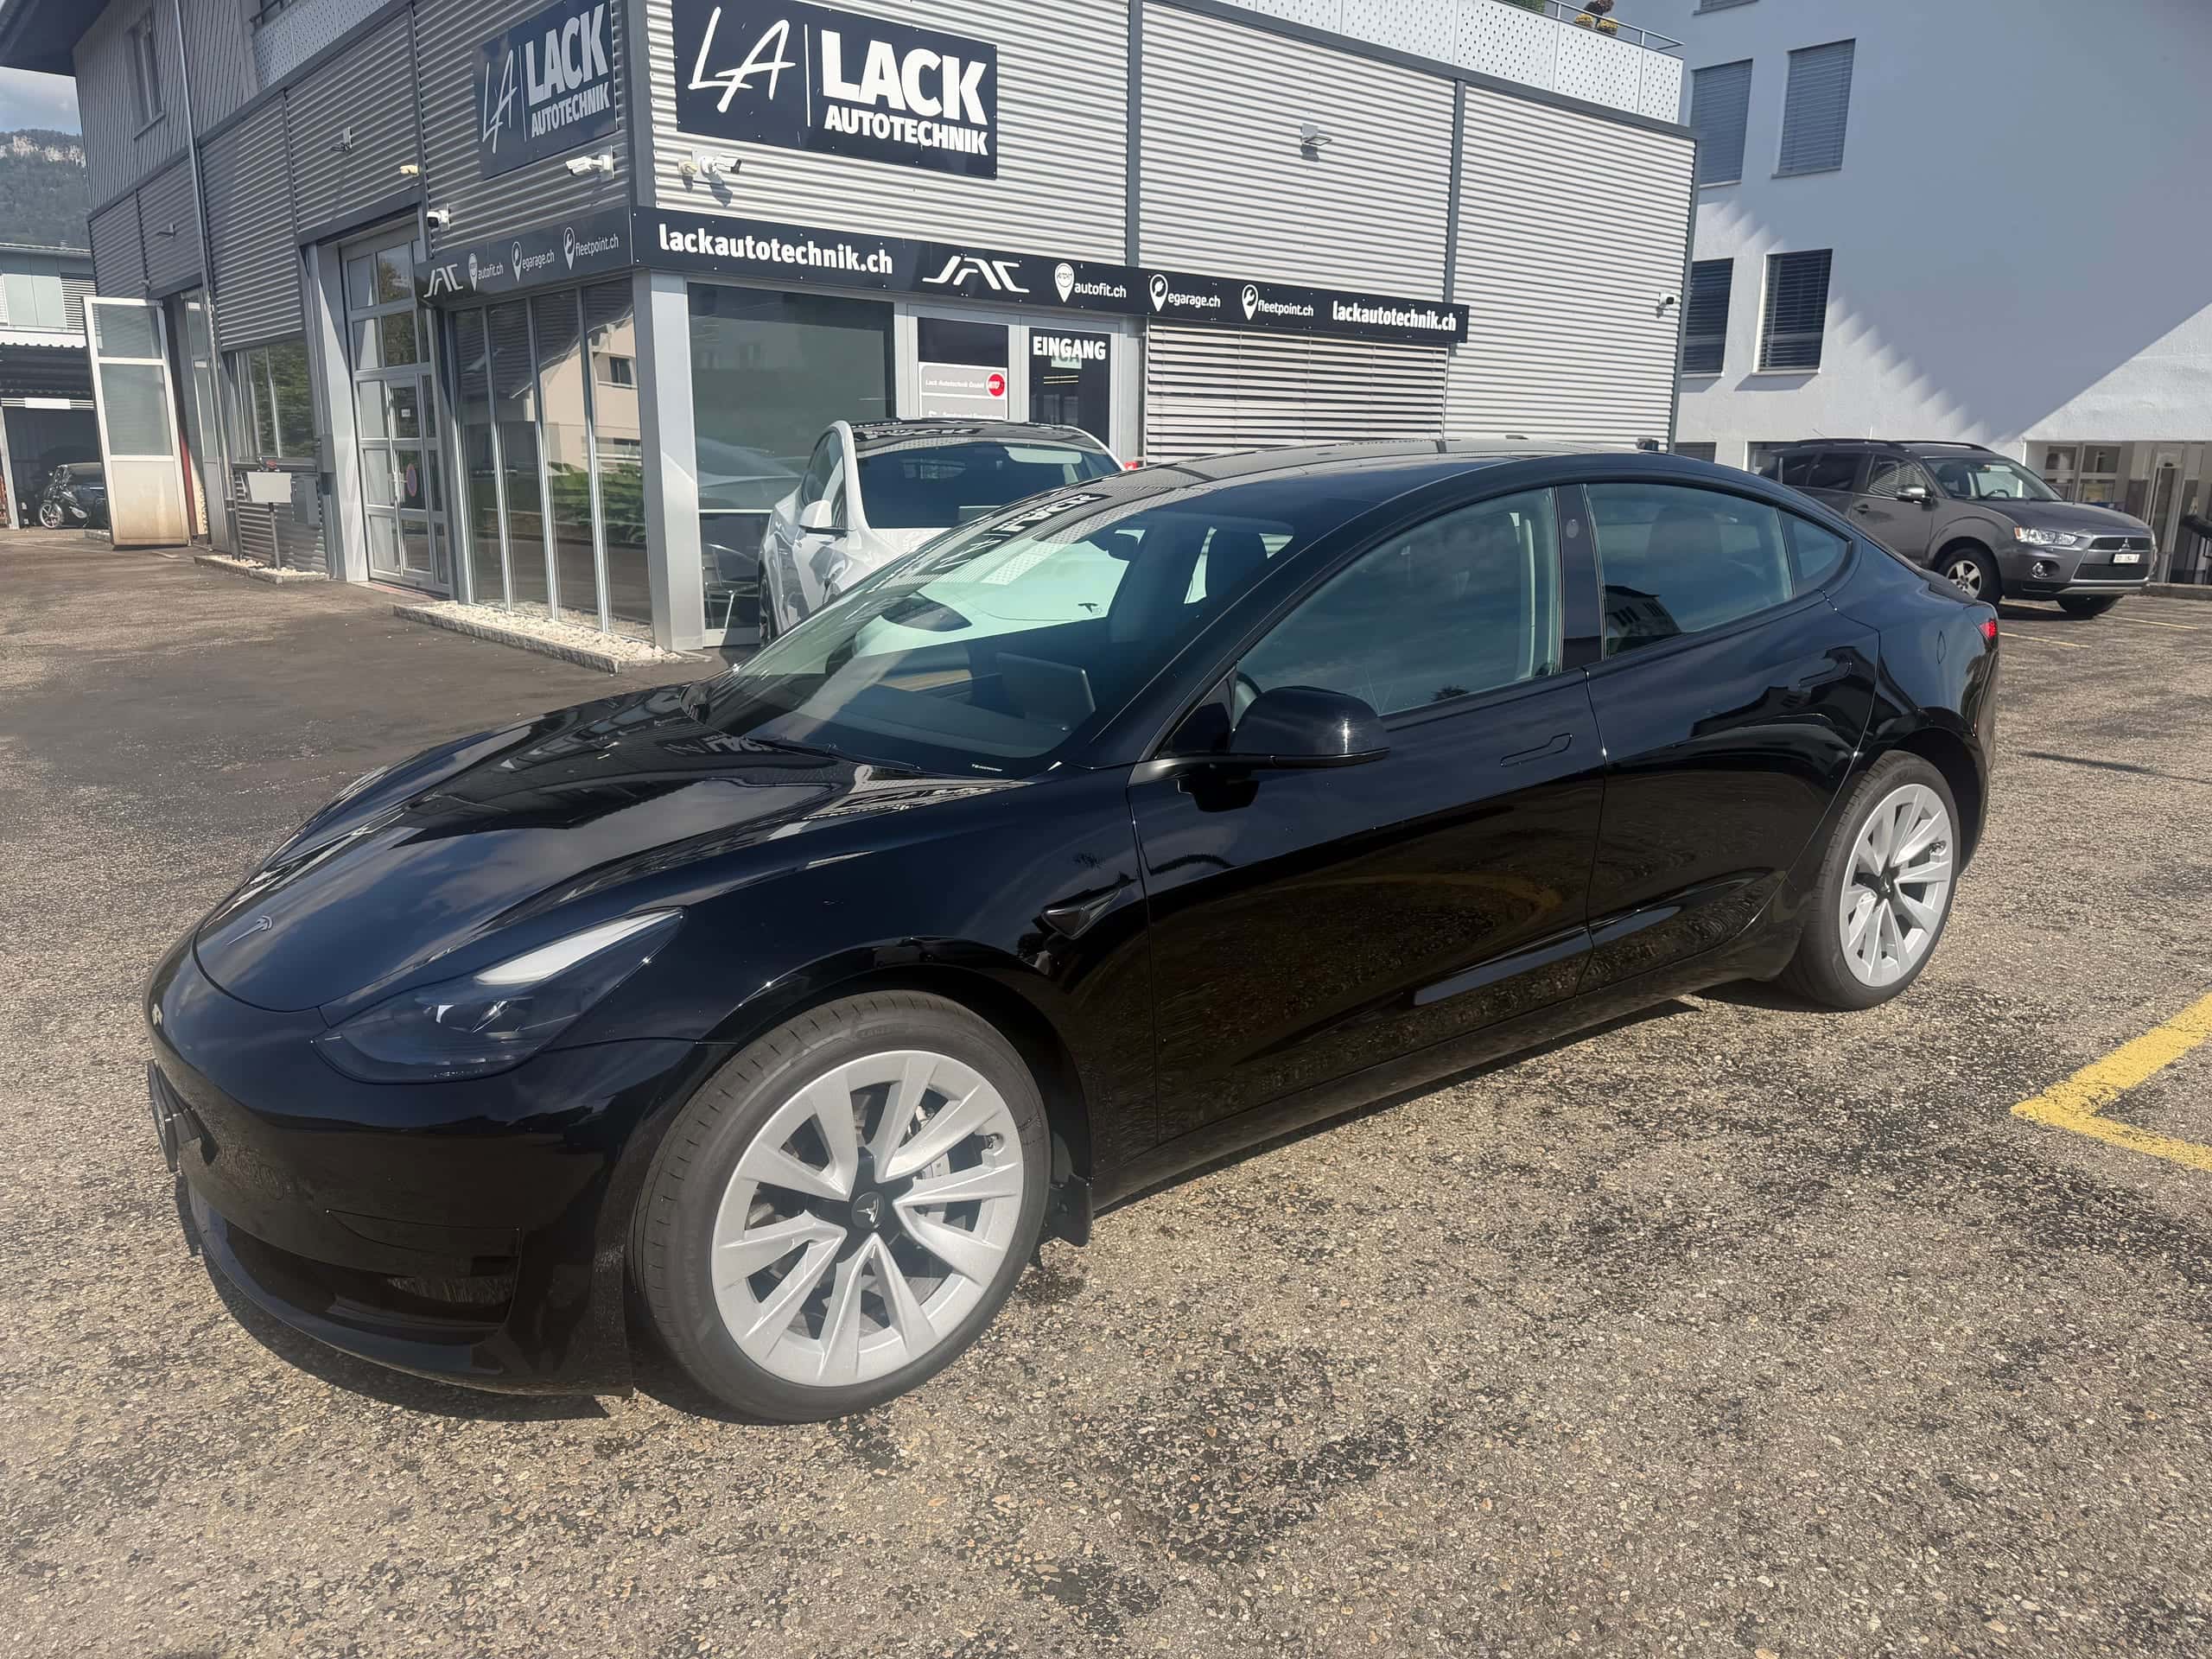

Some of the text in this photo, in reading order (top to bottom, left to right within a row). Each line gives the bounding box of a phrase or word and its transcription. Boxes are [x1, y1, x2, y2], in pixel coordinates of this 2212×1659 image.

[525, 3, 609, 106] LACK
[688, 7, 796, 113] LA
[822, 29, 988, 125] LACK
[482, 49, 518, 154] LA
[531, 82, 611, 138] AUTOTECHNIK
[823, 105, 989, 156] AUTOTECHNIK
[522, 250, 555, 270] egarage.ch
[575, 233, 619, 257] fleetpoint.ch
[658, 223, 893, 274] lackautotechnik.ch
[478, 264, 504, 280] autofit.ch
[1074, 281, 1127, 298] autofit.ch
[1167, 292, 1221, 309] egarage.ch
[1257, 299, 1314, 317] fleetpoint.ch
[1332, 301, 1457, 332] lackautotechnik.ch
[1033, 335, 1106, 360] EINGANG
